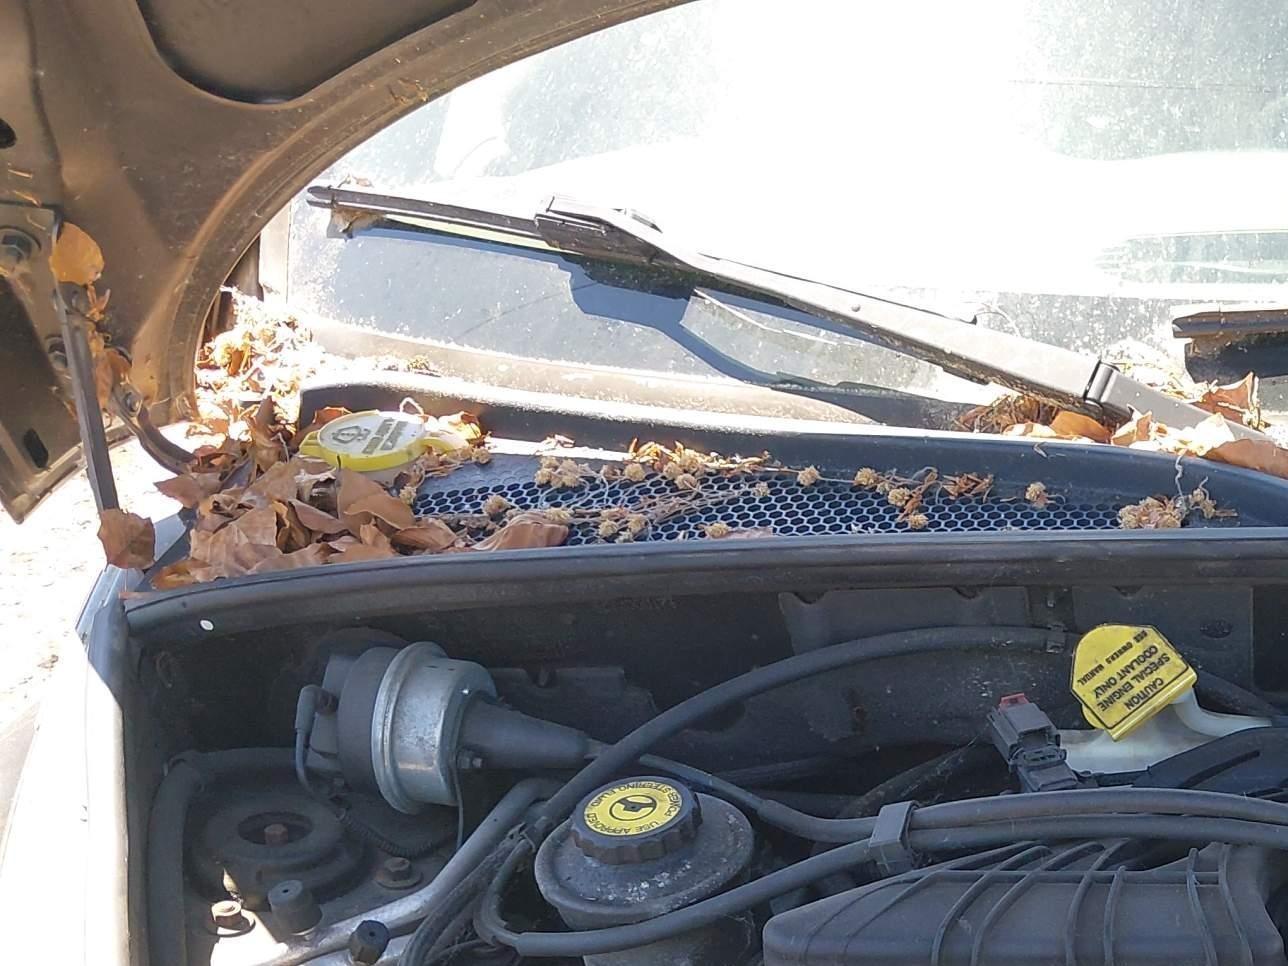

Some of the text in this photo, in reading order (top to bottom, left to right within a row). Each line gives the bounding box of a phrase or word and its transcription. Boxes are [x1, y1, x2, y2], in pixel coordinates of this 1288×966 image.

[1077, 664, 1105, 685] MANUAL
[1094, 645, 1158, 699] COOLANT ONLY
[1097, 653, 1170, 712] SPECIAL ENGINE
[1124, 677, 1164, 710] CAUTION
[635, 822, 660, 832] USE
